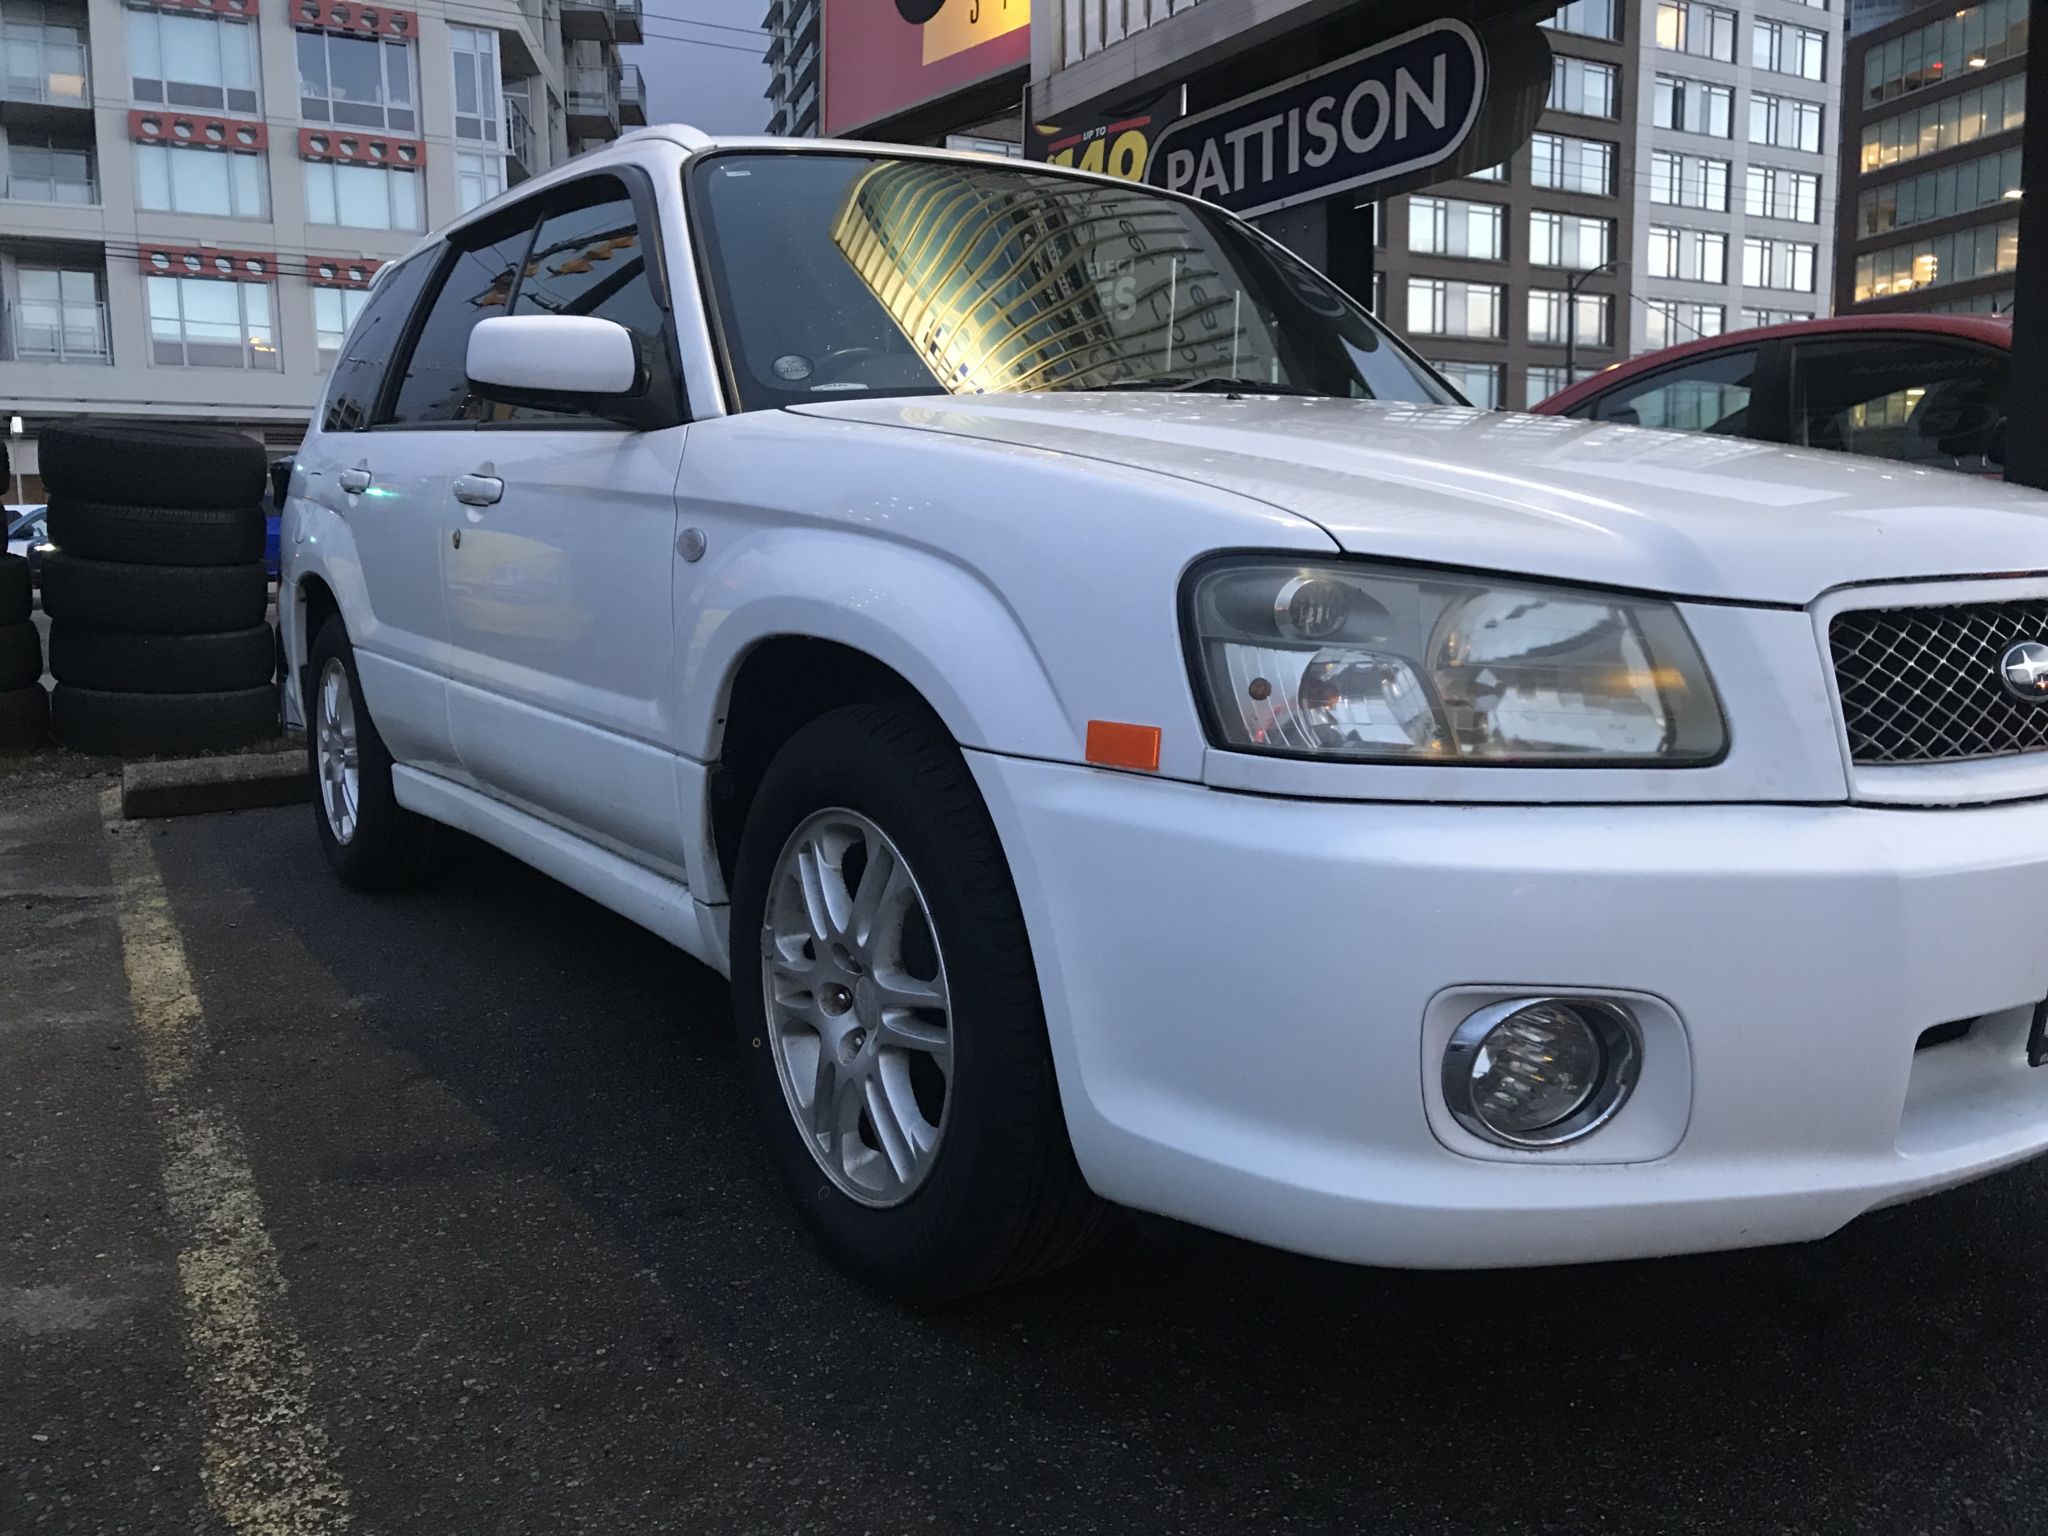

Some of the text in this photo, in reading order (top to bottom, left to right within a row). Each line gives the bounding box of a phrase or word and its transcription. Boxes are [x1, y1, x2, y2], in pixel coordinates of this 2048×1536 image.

[1083, 126, 1106, 141] UP TO
[1166, 53, 1448, 199] PATTISON
